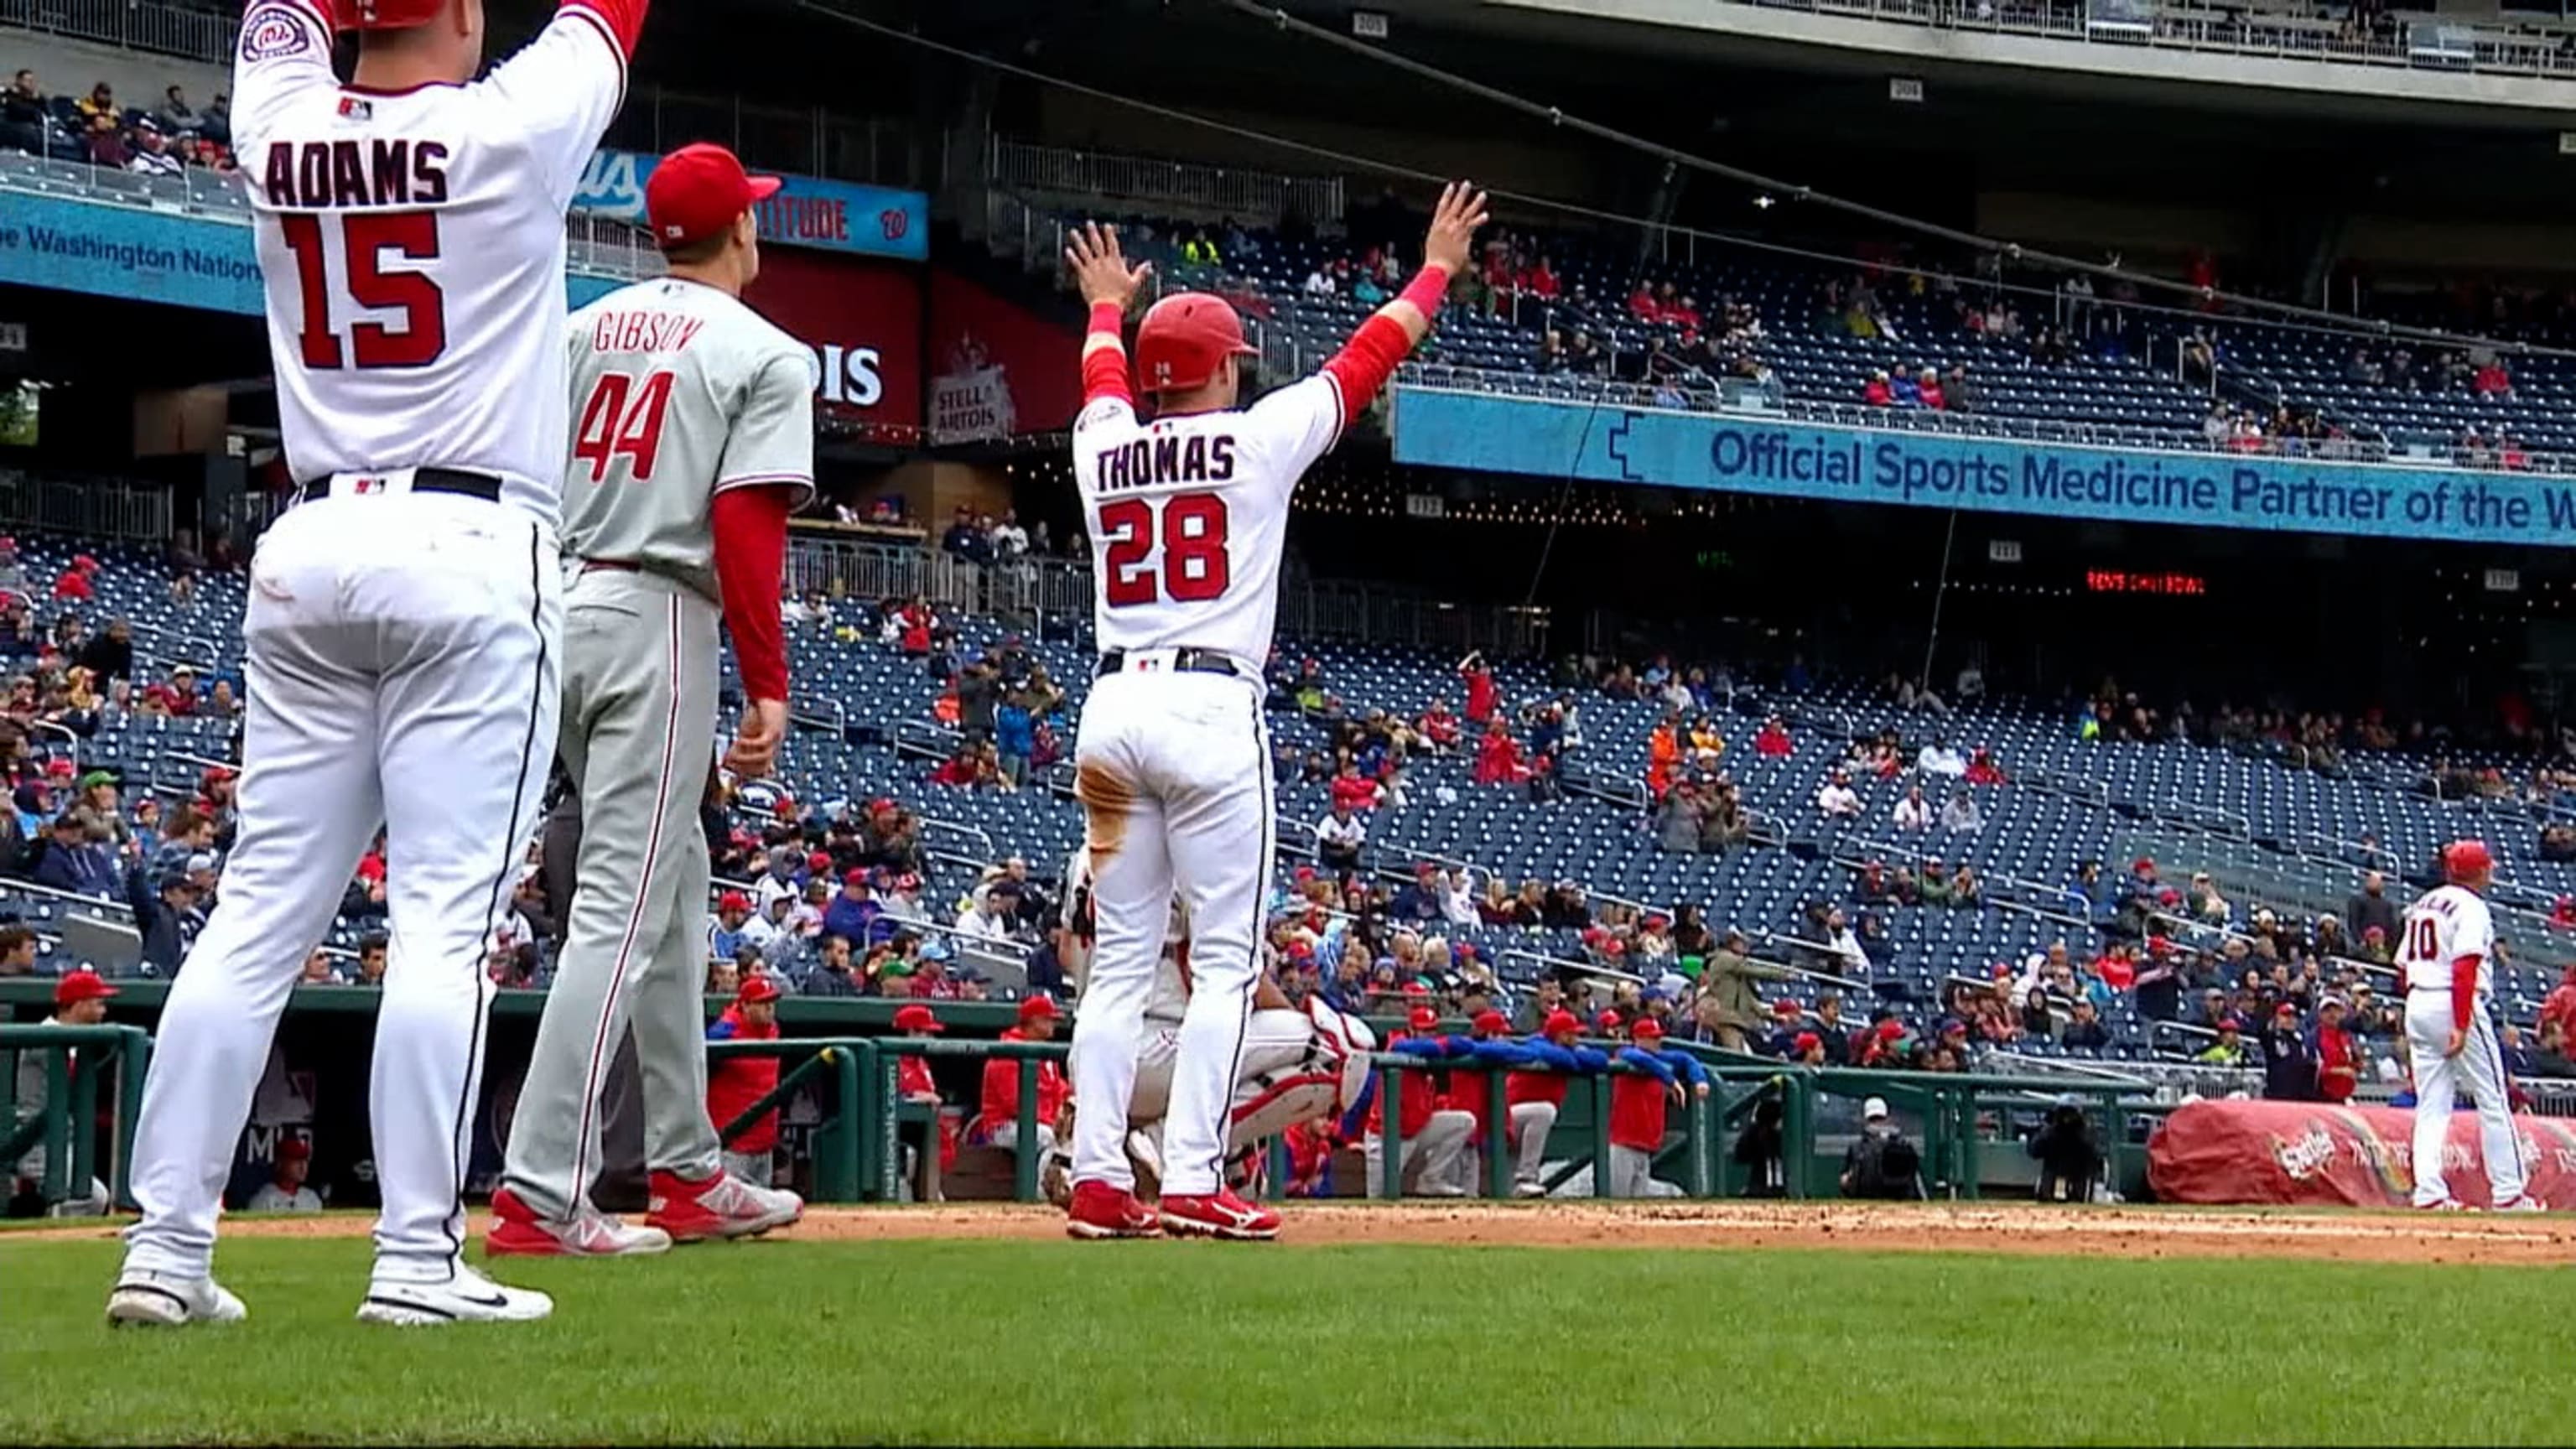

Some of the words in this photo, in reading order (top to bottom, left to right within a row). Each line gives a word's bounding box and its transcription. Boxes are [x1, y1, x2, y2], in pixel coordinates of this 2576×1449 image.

[267, 140, 448, 207] ADAMS
[26, 224, 175, 271] Washington
[279, 210, 447, 370] 15
[595, 311, 704, 353] GIBSON
[574, 371, 674, 483] 44
[938, 408, 995, 431] ARTOIS
[1098, 434, 1235, 492] THOMAS
[1711, 429, 1862, 485] Official
[1874, 443, 2009, 500] Sports
[2022, 454, 2218, 510] Medicine
[2231, 468, 2393, 522] Partner
[2405, 481, 2451, 522] of
[2459, 484, 2531, 529] the
[1098, 491, 1230, 609] 28
[2407, 917, 2438, 962] 10
